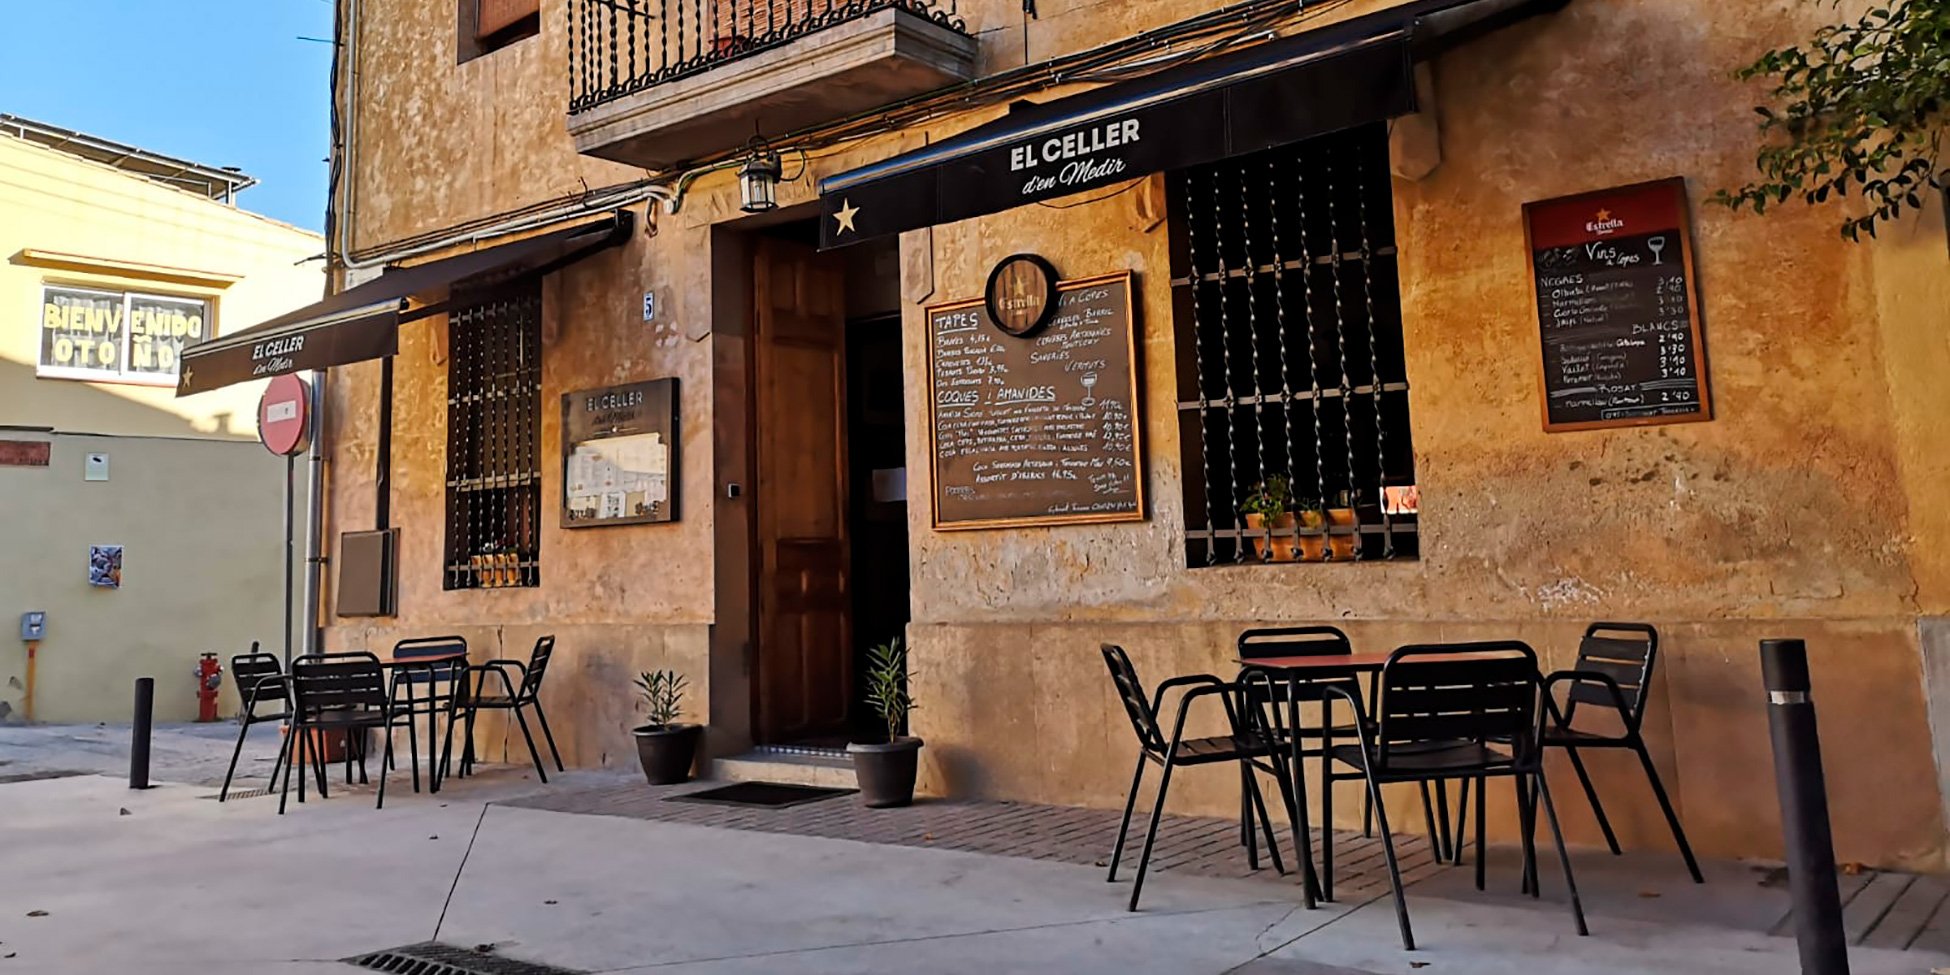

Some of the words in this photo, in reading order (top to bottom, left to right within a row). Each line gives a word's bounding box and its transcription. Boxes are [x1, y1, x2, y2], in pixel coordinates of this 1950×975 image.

[1011, 145, 1038, 171] EL
[1042, 119, 1140, 163] CELLER
[1022, 175, 1057, 194] d'en
[1059, 158, 1127, 185] Medir
[1586, 219, 1624, 232] Estrella
[1585, 241, 1616, 260] Vins
[645, 296, 652, 317] 5
[935, 311, 978, 329] TAPES
[252, 344, 264, 360] EL
[265, 335, 305, 357] CELLER
[586, 397, 599, 412] EL
[602, 392, 643, 410] CELLER
[936, 390, 980, 403] COQUES
[997, 386, 1056, 400] AMANIDES
